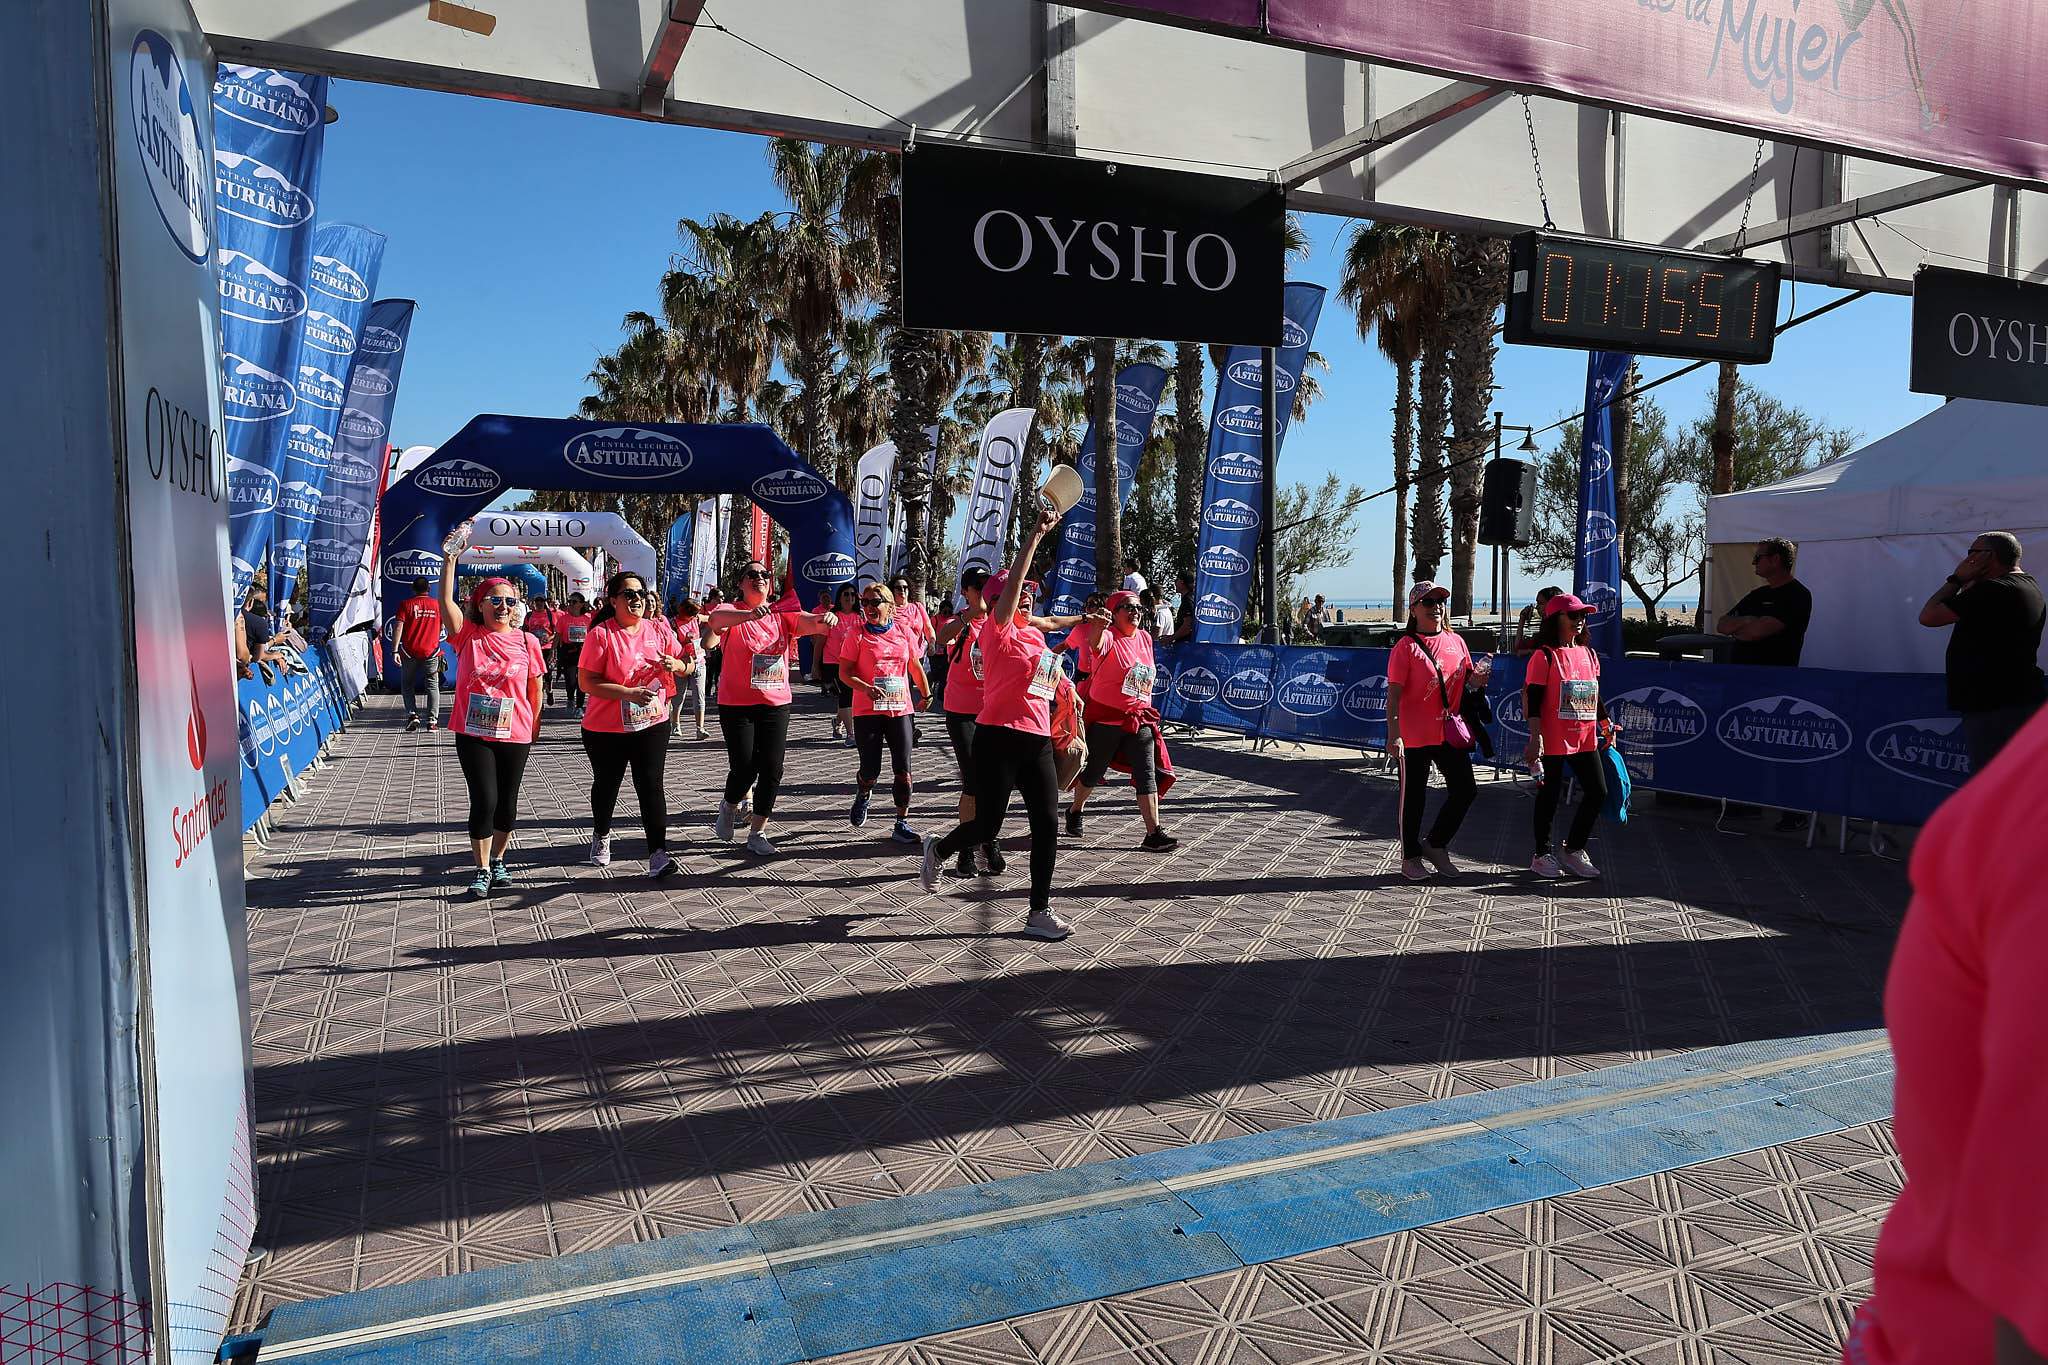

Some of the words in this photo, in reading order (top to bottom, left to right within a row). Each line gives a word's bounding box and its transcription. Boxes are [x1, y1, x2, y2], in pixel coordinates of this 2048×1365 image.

[1706, 0, 1862, 114] Mujer
[139, 69, 209, 236] ASTURIANA
[218, 168, 252, 186] NTRAL
[257, 179, 300, 201] LECHERA
[973, 209, 1238, 292] OYSHO
[248, 279, 294, 295] LECHERA
[1541, 253, 1760, 338] 01:15:51
[238, 379, 285, 391] LECHERA
[146, 387, 222, 503] OYSHO
[574, 441, 684, 467] ASTURIANA
[594, 441, 636, 449] CENTRAL
[419, 472, 494, 489] ASTURIANA
[758, 482, 823, 496] ASTURIANA
[489, 518, 586, 537] OYSHO
[1224, 682, 1269, 701] ASTURIANA
[1281, 687, 1333, 707] ASTURIANA
[1724, 716, 1839, 750] ASTURIANA
[1744, 716, 1789, 726] CENTRAL
[1790, 720, 1837, 730] LECHERA
[172, 775, 228, 870] Santander
